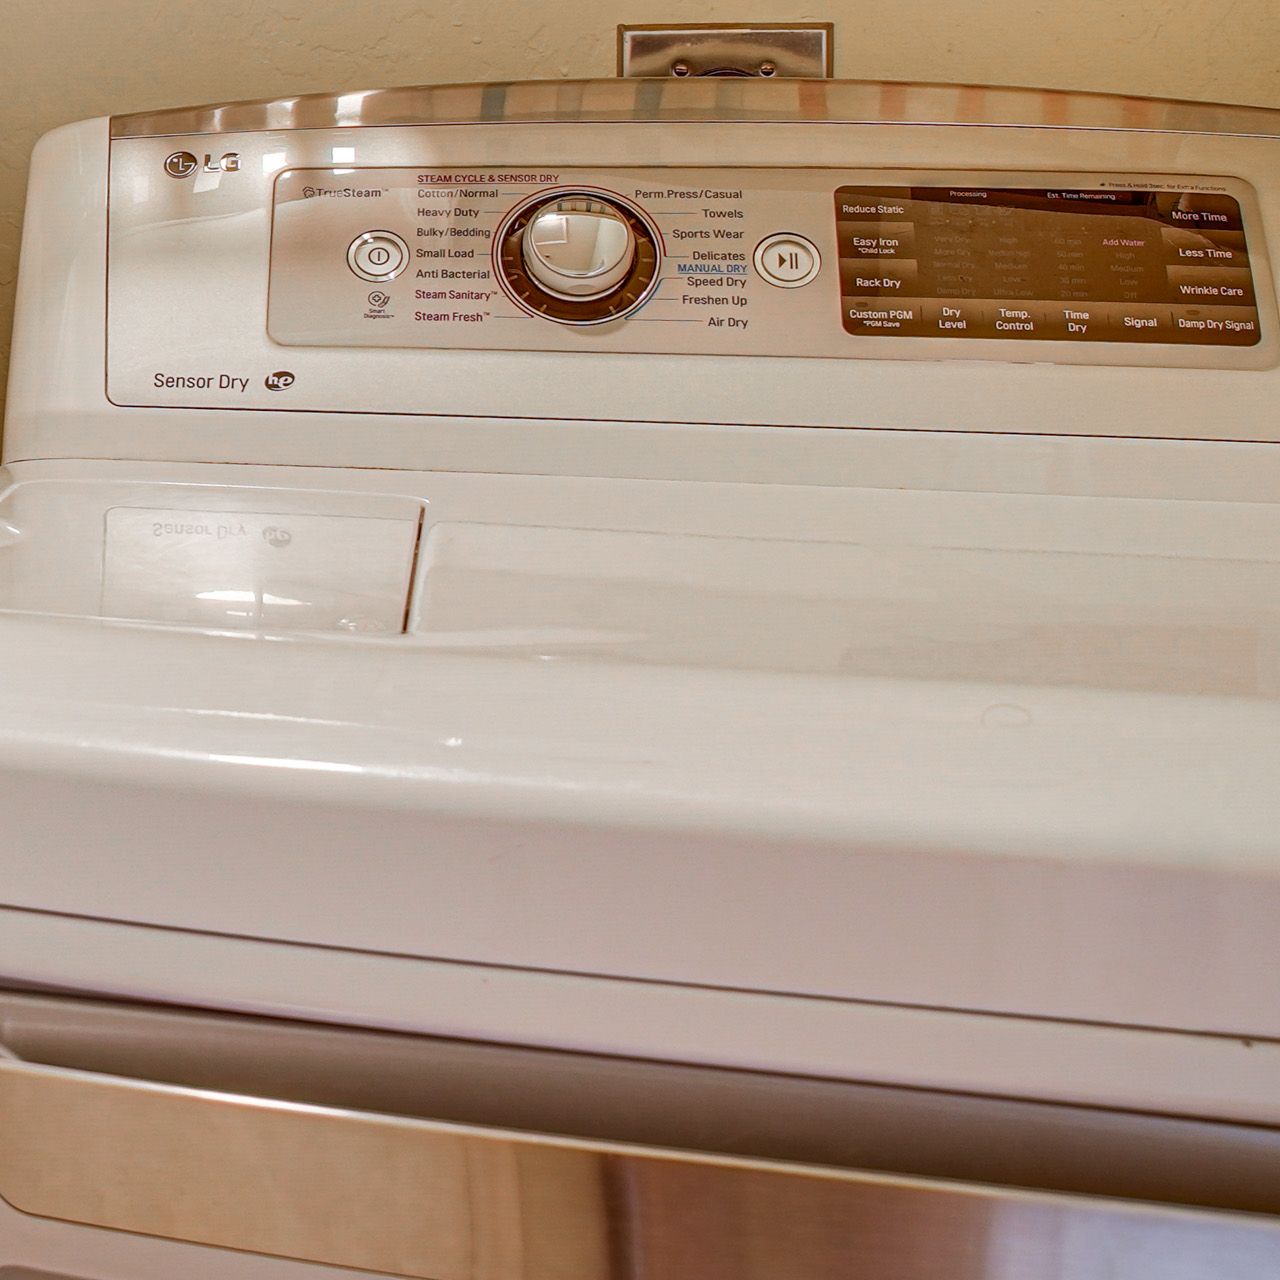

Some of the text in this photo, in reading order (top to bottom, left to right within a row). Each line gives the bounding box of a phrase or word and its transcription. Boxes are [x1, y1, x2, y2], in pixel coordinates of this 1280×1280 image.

[417, 174, 559, 183] STEAM CYCLE & SENSOR DRY
[417, 189, 499, 199] Cotton/Normal
[635, 189, 743, 199] Perm.Press/Casual
[950, 190, 988, 198] Processing
[1062, 192, 1079, 200] Time
[1080, 193, 1116, 201] Remaining
[417, 207, 480, 219] Heavy Duty
[702, 208, 744, 219] Towels
[842, 204, 904, 214] Reduce Static
[1171, 211, 1227, 222] More Time
[416, 227, 491, 238] Bulky/Bedding
[672, 229, 744, 240] Sports Wear
[853, 237, 899, 247] Easy Iron
[1120, 239, 1145, 247] Water
[416, 248, 474, 258] Small Load
[692, 250, 746, 261] Delicates
[1179, 248, 1233, 259] Less Time
[677, 263, 747, 273] MANUAL DRY
[416, 269, 490, 279] Anti Bacterial
[687, 276, 747, 288] Speed Dry
[856, 277, 901, 289] Rack Dry
[415, 289, 447, 299] Steam
[1179, 285, 1244, 296] Wrinkle Care
[682, 294, 748, 307] Freshen Up
[414, 311, 451, 321] Steam
[849, 309, 913, 320] Custom PGM
[942, 307, 961, 318] Dry
[999, 308, 1031, 320] Temp.
[1063, 310, 1089, 320] Time
[707, 317, 749, 329] Air Dry
[938, 319, 967, 329] Level
[995, 320, 1034, 331] Control
[1067, 322, 1087, 334] Dry
[1123, 316, 1158, 329] Signal
[1178, 318, 1255, 332] Damp Dry Signal
[153, 372, 214, 389] Sensor
[219, 374, 249, 392] Dry
